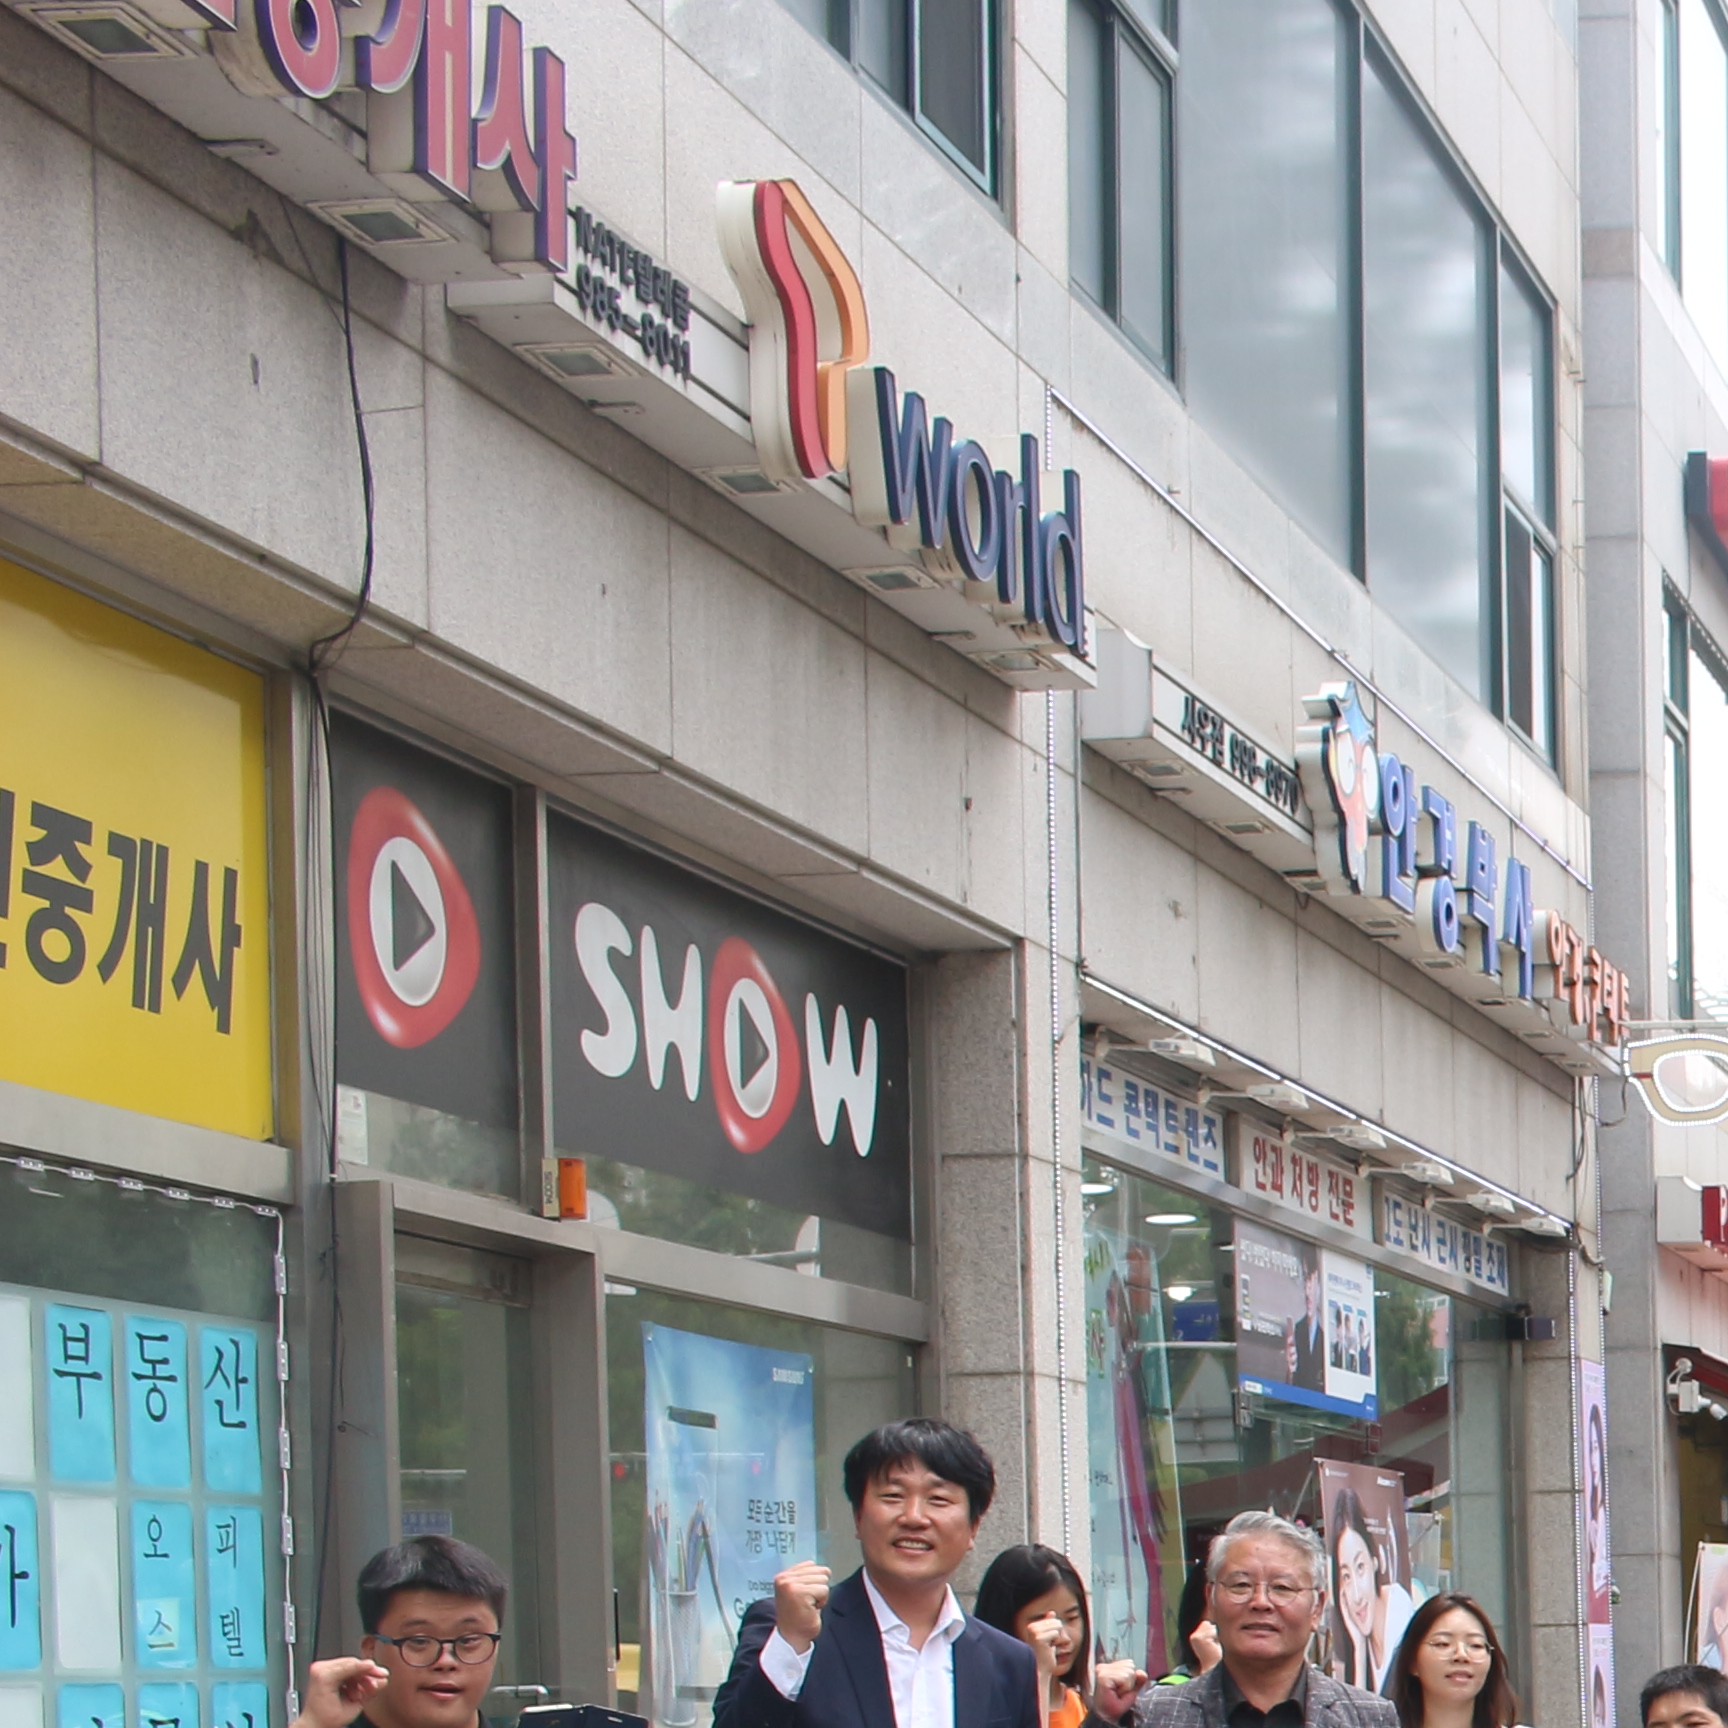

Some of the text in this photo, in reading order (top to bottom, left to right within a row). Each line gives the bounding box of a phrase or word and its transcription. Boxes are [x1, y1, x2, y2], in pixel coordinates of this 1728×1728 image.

[576, 263, 691, 388] 985-8011
[874, 366, 1089, 658] World
[0, 787, 243, 1036] 중개사
[1379, 752, 1534, 1000] 안경박사
[574, 902, 878, 1158] SHOW
[1252, 1135, 1356, 1228] 안과 처방 전문
[53, 1322, 249, 1429] 부동산
[772, 1366, 805, 1385] SAMSUNG
